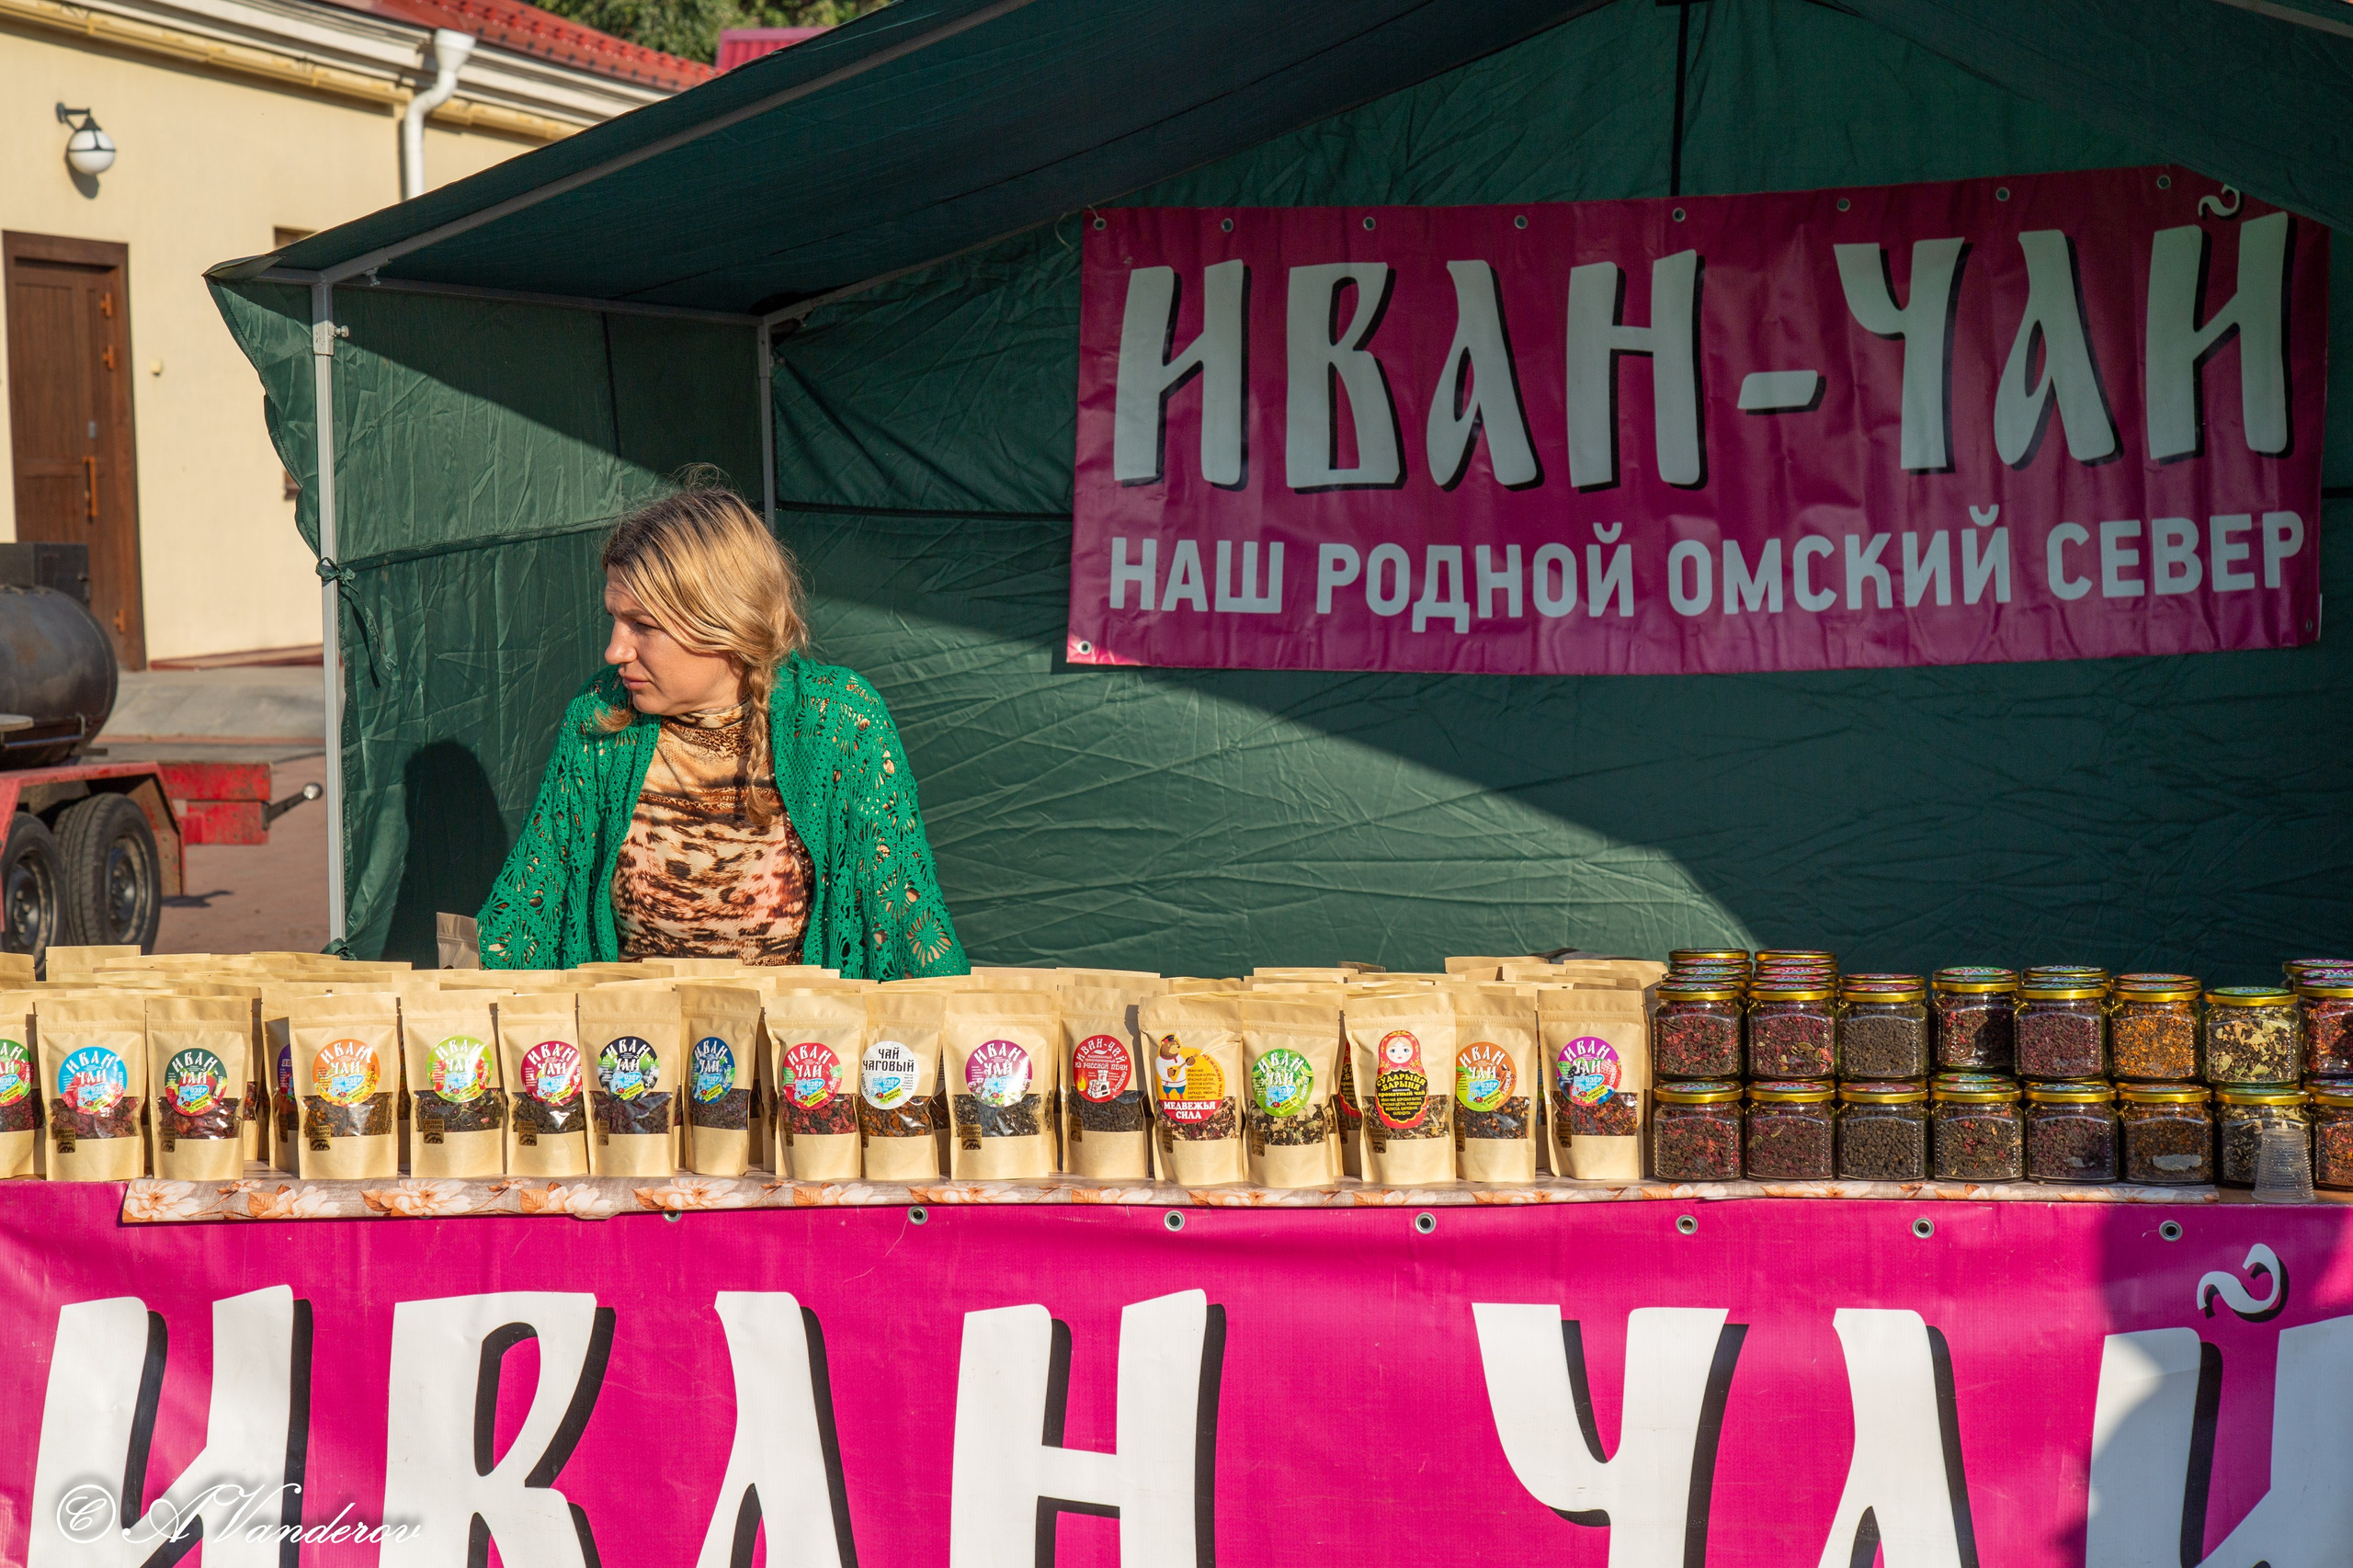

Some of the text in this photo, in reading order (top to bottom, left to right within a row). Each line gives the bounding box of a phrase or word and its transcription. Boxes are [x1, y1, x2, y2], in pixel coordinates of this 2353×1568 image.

[1109, 505, 2303, 633] НАШ РОДНОЙ ОМСКИЙ СЕВЕР
[878, 1047, 900, 1060] ЧАЙ
[331, 1057, 360, 1074] ЧАЙ
[538, 1058, 566, 1074] ЧАЙ
[615, 1054, 640, 1071] ЧАЙ
[795, 1060, 823, 1077] ЧАЙ
[863, 1059, 915, 1073] ЧАГОВЫЙ
[983, 1058, 1013, 1075] ЧАЙ
[1468, 1062, 1496, 1079] ЧАЙ
[1573, 1056, 1601, 1074] ЧАЙ
[76, 1064, 107, 1085] ЧАЙ
[180, 1067, 208, 1085] ЧАЙ
[1267, 1068, 1293, 1085] ЧАЙ
[1377, 1074, 1427, 1086] СУДАРЫНЯ
[1468, 1081, 1481, 1102] 5
[1164, 1101, 1216, 1110] МЕДВЕЖЬЯ
[1176, 1110, 1202, 1119] СИЛА
